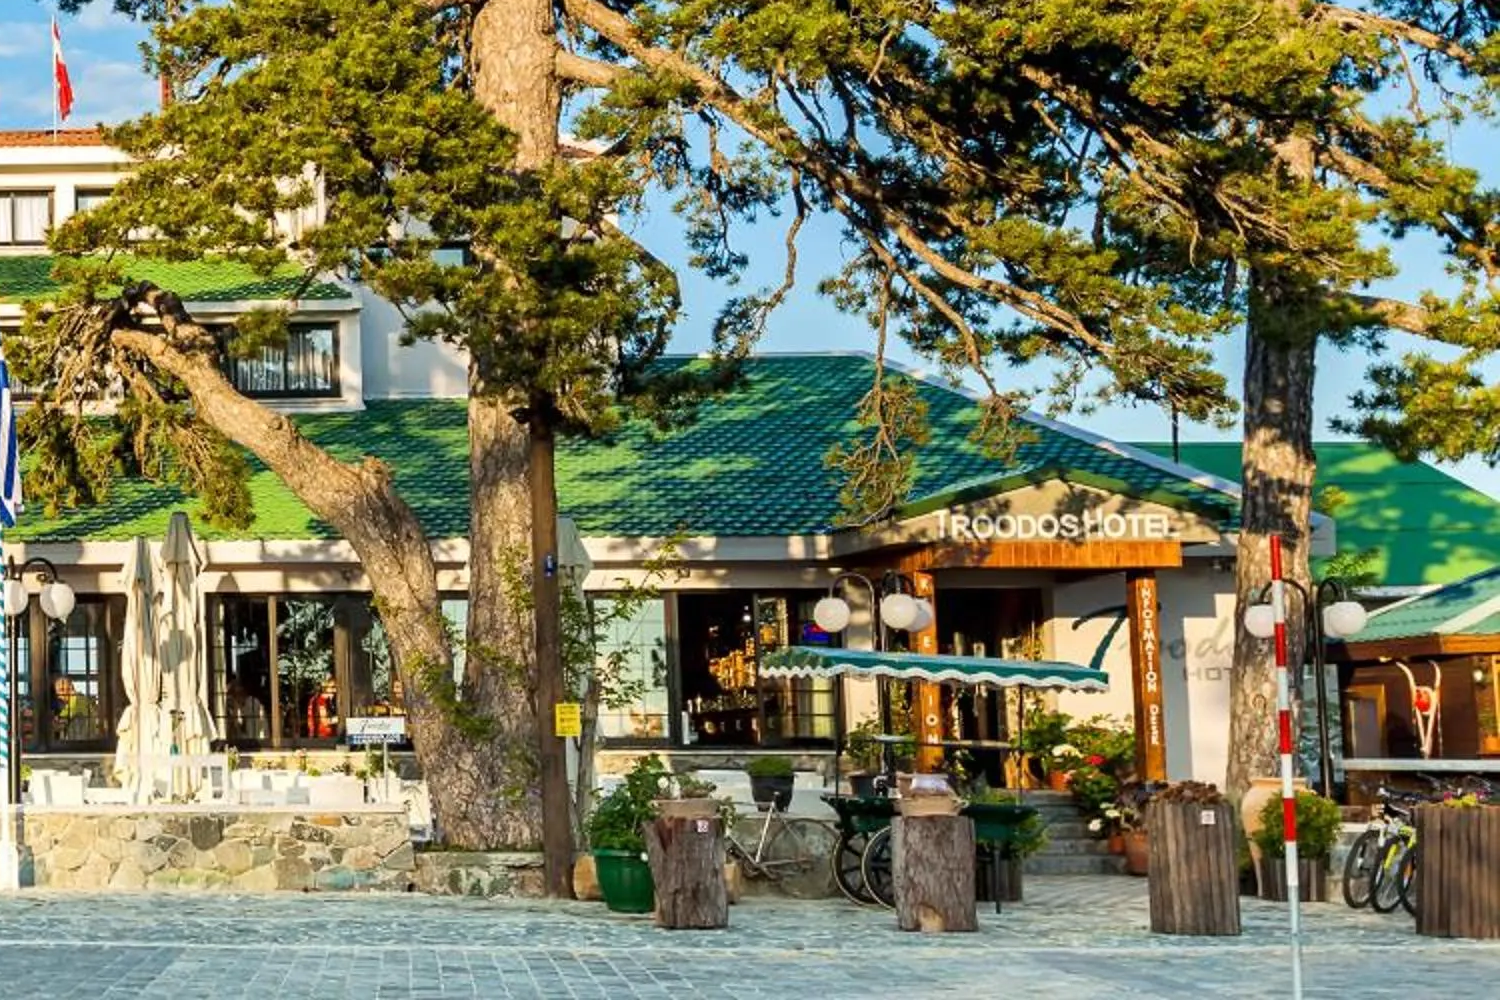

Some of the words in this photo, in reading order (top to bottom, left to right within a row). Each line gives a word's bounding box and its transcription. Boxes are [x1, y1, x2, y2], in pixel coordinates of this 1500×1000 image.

[936, 510, 1079, 539] TROODOS
[1082, 508, 1181, 538] HOTEL
[919, 576, 939, 744] REION
